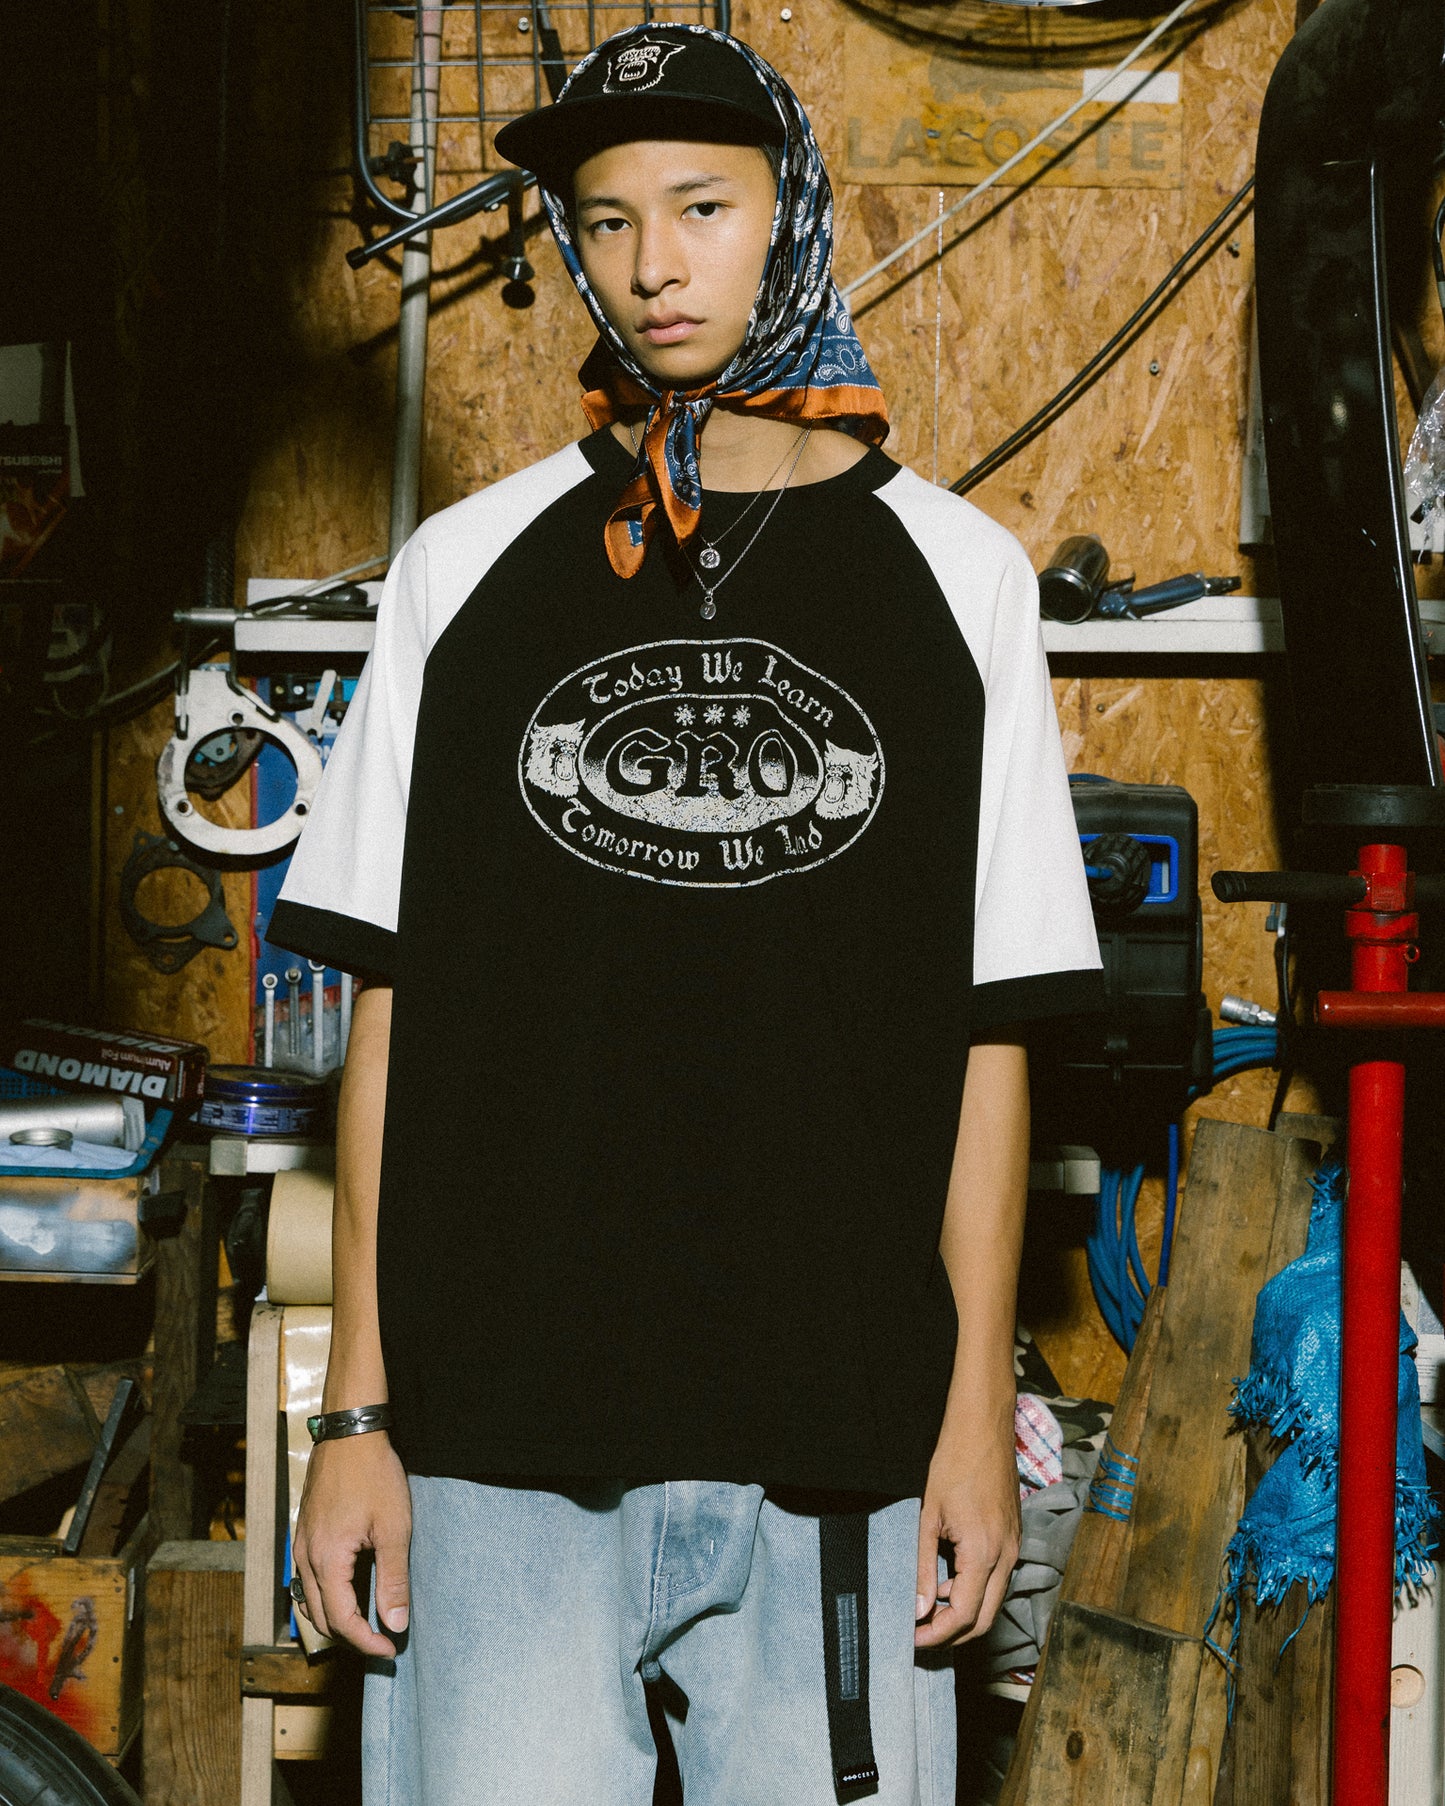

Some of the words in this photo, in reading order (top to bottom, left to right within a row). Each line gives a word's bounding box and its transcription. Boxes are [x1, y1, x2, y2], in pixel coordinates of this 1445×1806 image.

[847, 116, 1168, 171] LACOSTE
[582, 663, 683, 704] Today
[701, 650, 742, 684] We
[757, 652, 834, 728] Learn
[604, 727, 798, 800] GRO
[562, 798, 700, 870] Tomorrow
[719, 835, 764, 871] We
[14, 1049, 168, 1100] DIAMOND
[101, 1048, 119, 1062] Foil
[119, 1051, 172, 1072] Aluminum
